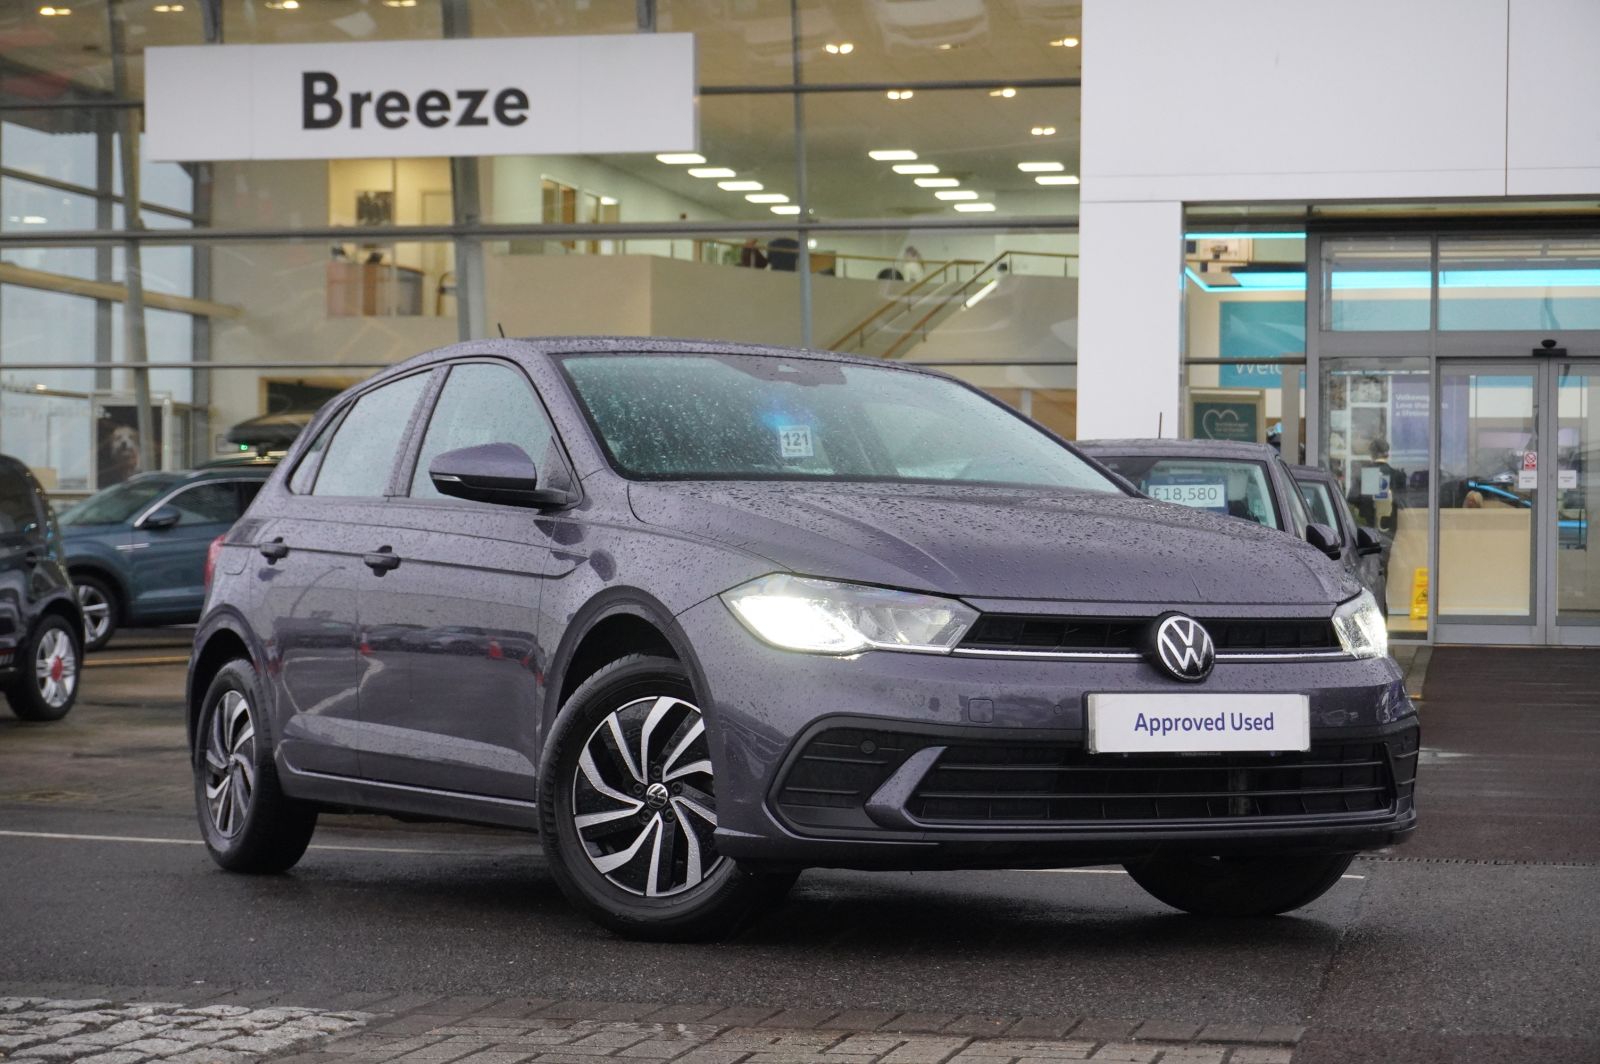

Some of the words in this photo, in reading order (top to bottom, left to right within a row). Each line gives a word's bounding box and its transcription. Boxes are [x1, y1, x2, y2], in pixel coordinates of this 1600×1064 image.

[302, 71, 530, 130] Breeze
[783, 431, 809, 447] 121
[1153, 487, 1217, 502] £18,580
[1158, 616, 1214, 679] VW
[1134, 712, 1226, 736] Approved
[1230, 712, 1274, 731] Used
